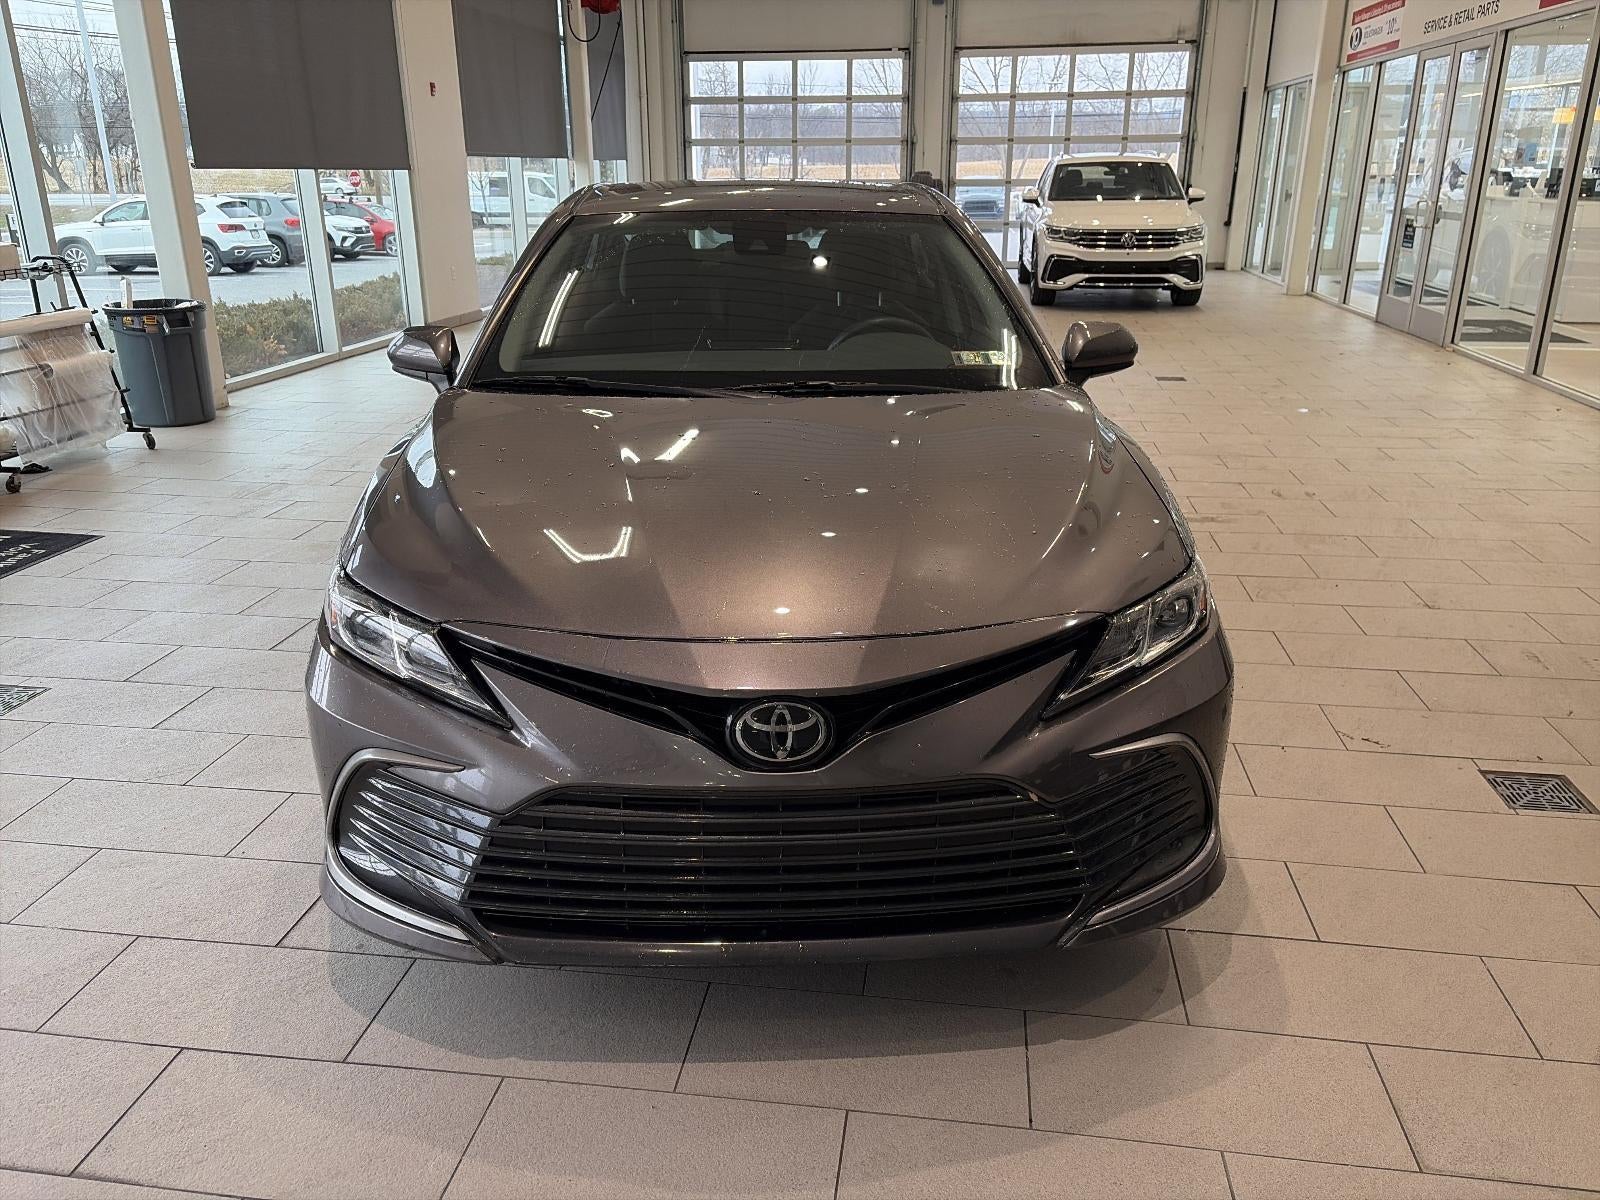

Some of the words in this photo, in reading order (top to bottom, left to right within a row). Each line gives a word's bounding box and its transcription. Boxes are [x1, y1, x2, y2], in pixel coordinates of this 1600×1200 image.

[1423, 15, 1448, 35] SERVICE
[1454, 7, 1475, 26] RETAIL
[1476, 0, 1500, 19] PARTS
